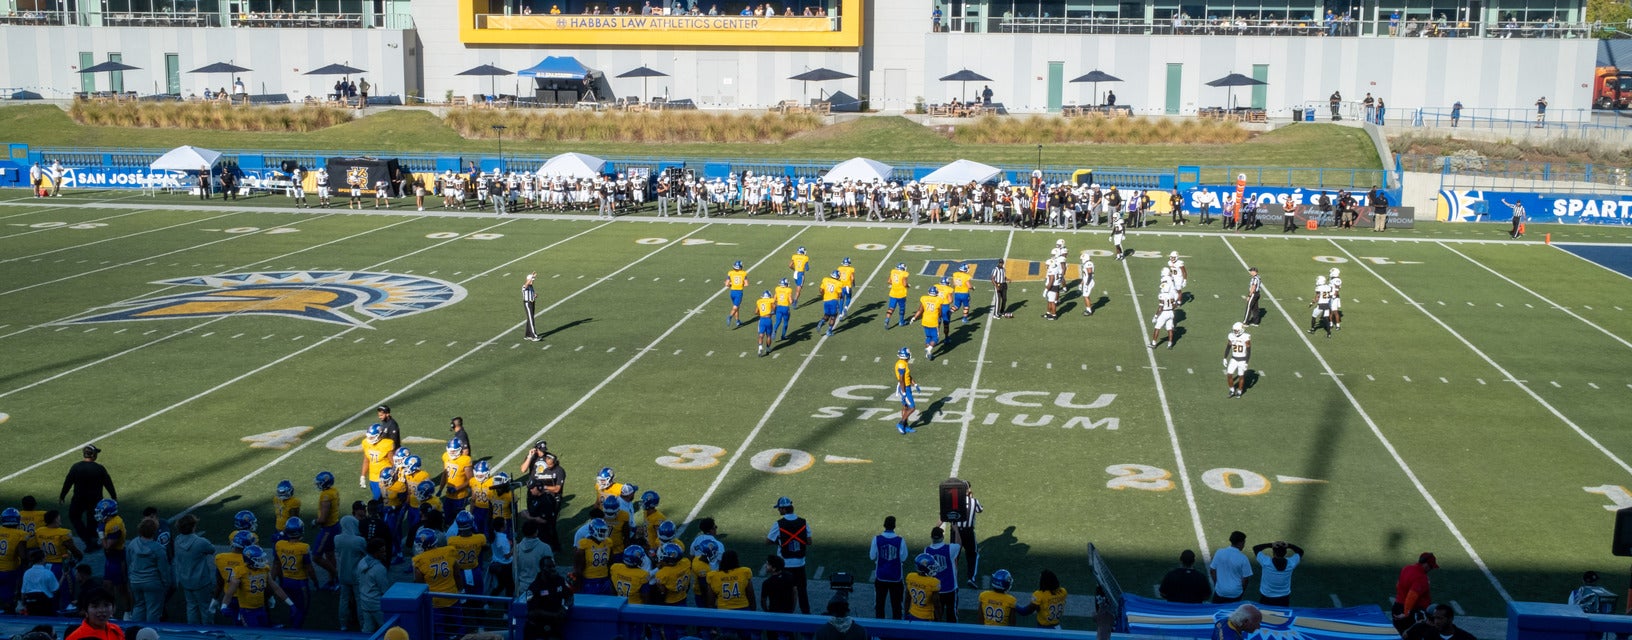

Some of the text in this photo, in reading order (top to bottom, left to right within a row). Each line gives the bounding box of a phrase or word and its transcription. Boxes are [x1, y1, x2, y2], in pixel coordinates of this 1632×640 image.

[570, 18, 617, 28] HABBAS
[621, 18, 646, 28] LAW
[650, 19, 710, 29] ATHLETICS
[713, 19, 758, 29] CENTER
[78, 173, 106, 184] SAN
[109, 169, 144, 185] JOSÉ
[1232, 344, 1244, 353] 20
[831, 384, 1118, 409] CEFCU
[811, 406, 1120, 430] STADIUM
[948, 487, 959, 511] 1
[280, 555, 297, 571] 22
[592, 552, 608, 567] 86
[430, 561, 450, 579] 76
[722, 582, 741, 600] 54
[910, 588, 927, 607] 32
[985, 605, 1005, 623] 99
